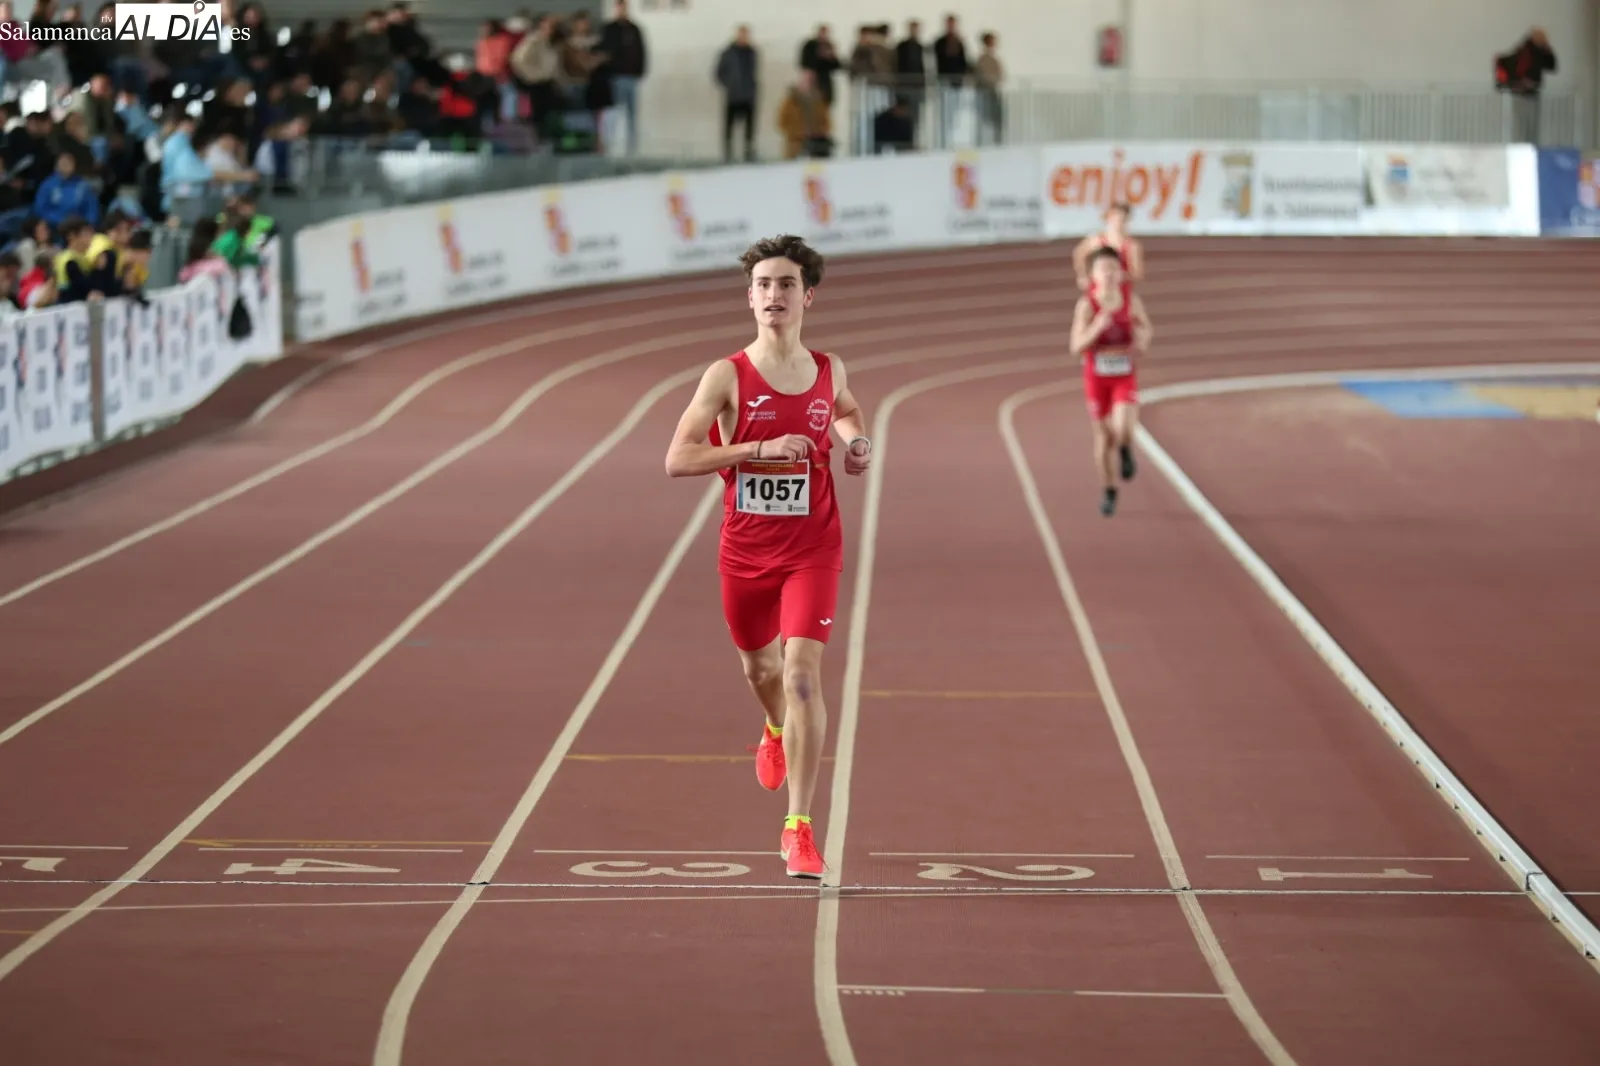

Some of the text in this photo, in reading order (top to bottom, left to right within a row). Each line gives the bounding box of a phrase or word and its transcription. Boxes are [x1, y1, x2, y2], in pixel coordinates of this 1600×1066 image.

[1049, 149, 1206, 220] enjoy!
[745, 478, 806, 501] 1057
[224, 858, 401, 876] 4
[570, 861, 750, 878] 3
[918, 863, 1095, 881] 2
[1258, 867, 1433, 881] 1
